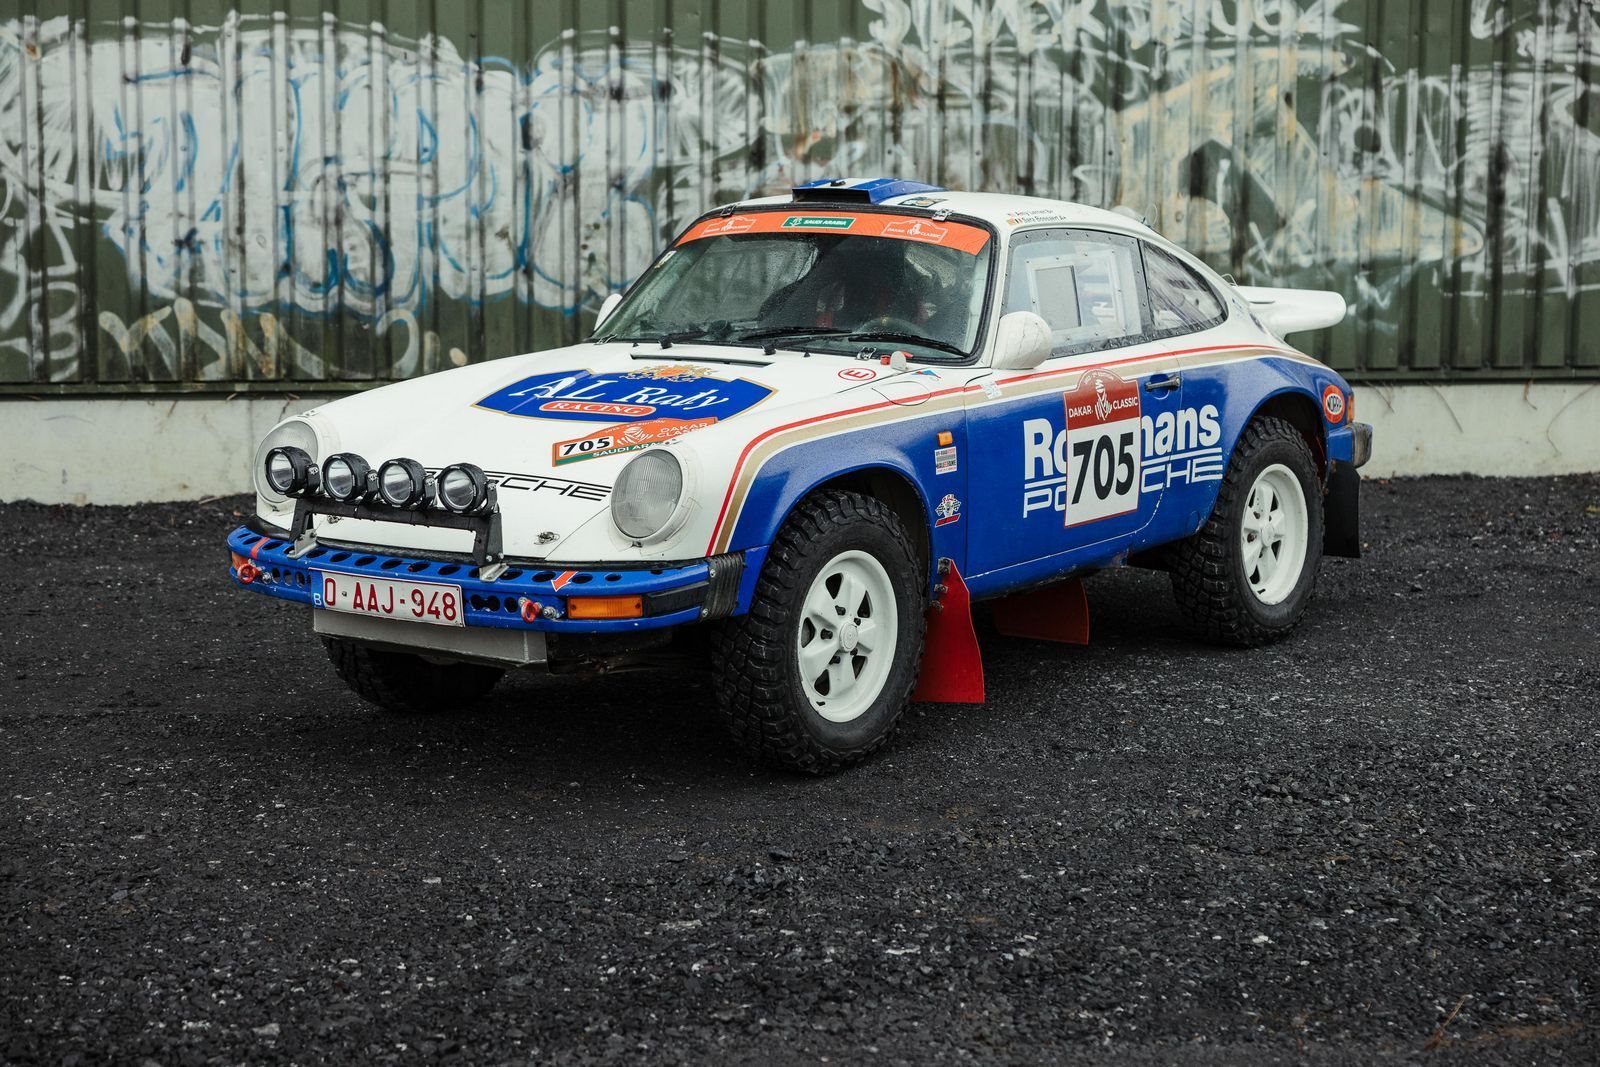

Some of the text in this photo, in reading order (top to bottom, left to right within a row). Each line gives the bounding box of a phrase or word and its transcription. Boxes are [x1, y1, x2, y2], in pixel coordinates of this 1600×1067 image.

[844, 369, 869, 379] E
[508, 376, 730, 411] AL Rally
[553, 401, 645, 414] RACING
[1068, 396, 1139, 418] DAKAR CLASSIC
[660, 422, 709, 433] DAKAR
[563, 437, 611, 456] 705
[592, 447, 630, 458] SAUDI
[1071, 431, 1135, 505] 705
[313, 592, 322, 606] B
